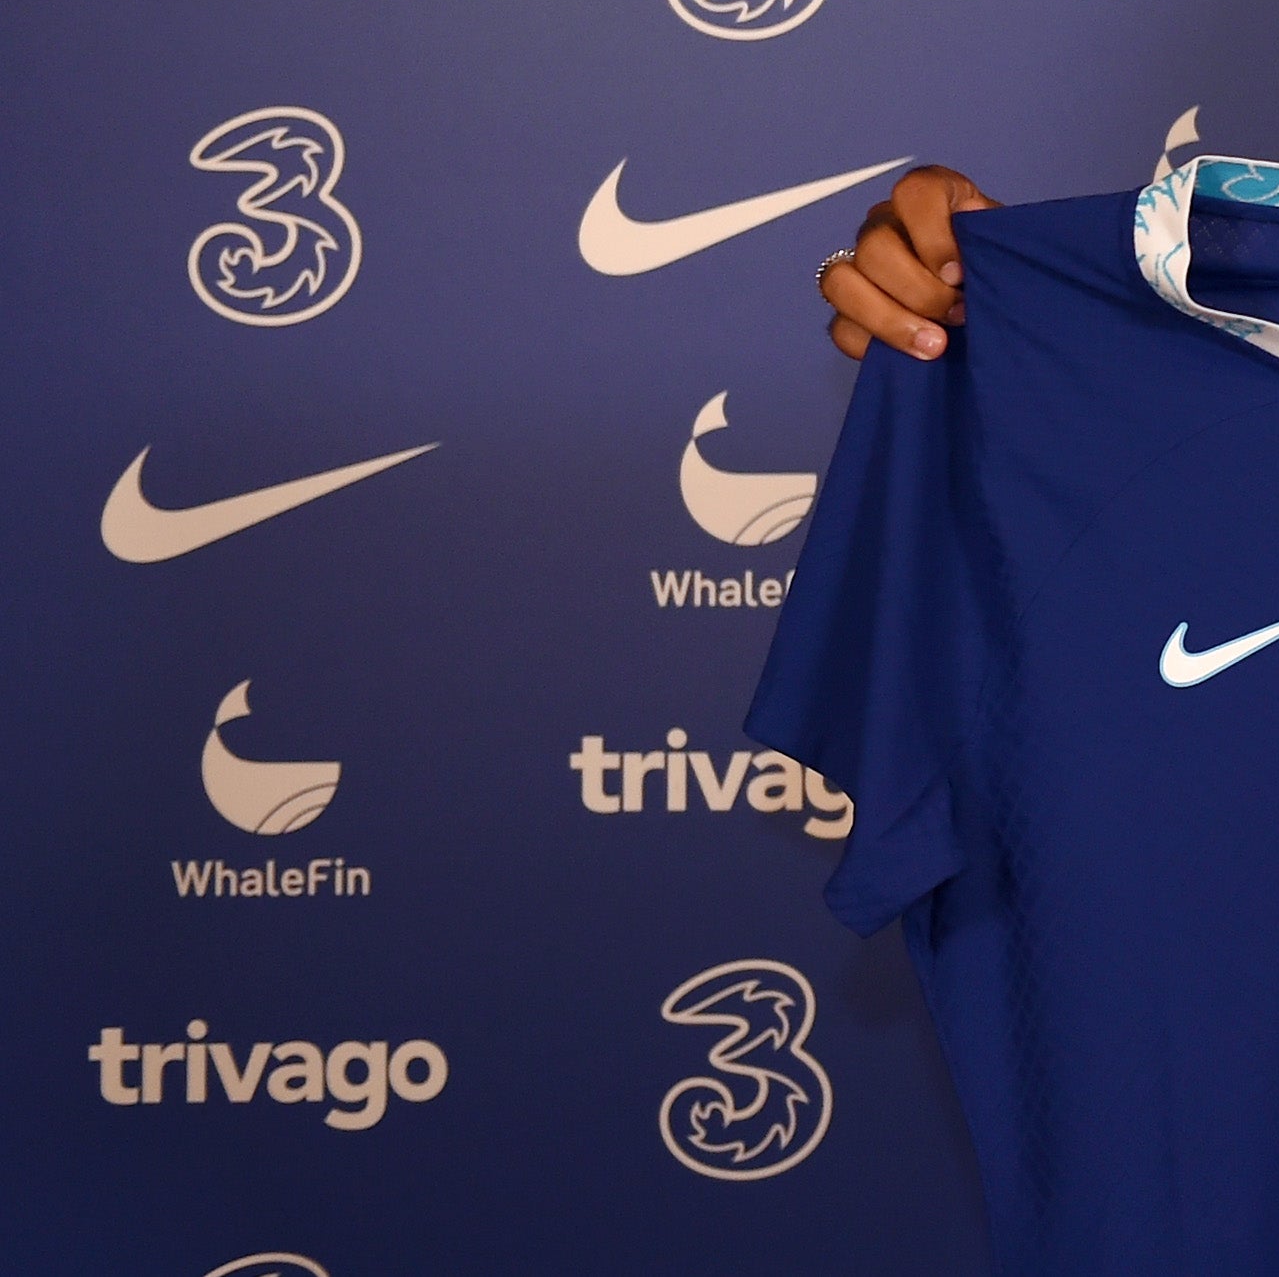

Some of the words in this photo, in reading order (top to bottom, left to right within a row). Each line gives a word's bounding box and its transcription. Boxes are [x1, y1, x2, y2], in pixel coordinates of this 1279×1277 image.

[188, 107, 362, 326] 3
[651, 570, 796, 607] Whale
[172, 858, 370, 897] WhaleFin
[88, 1019, 448, 1130] trivago
[659, 959, 833, 1181] 3
